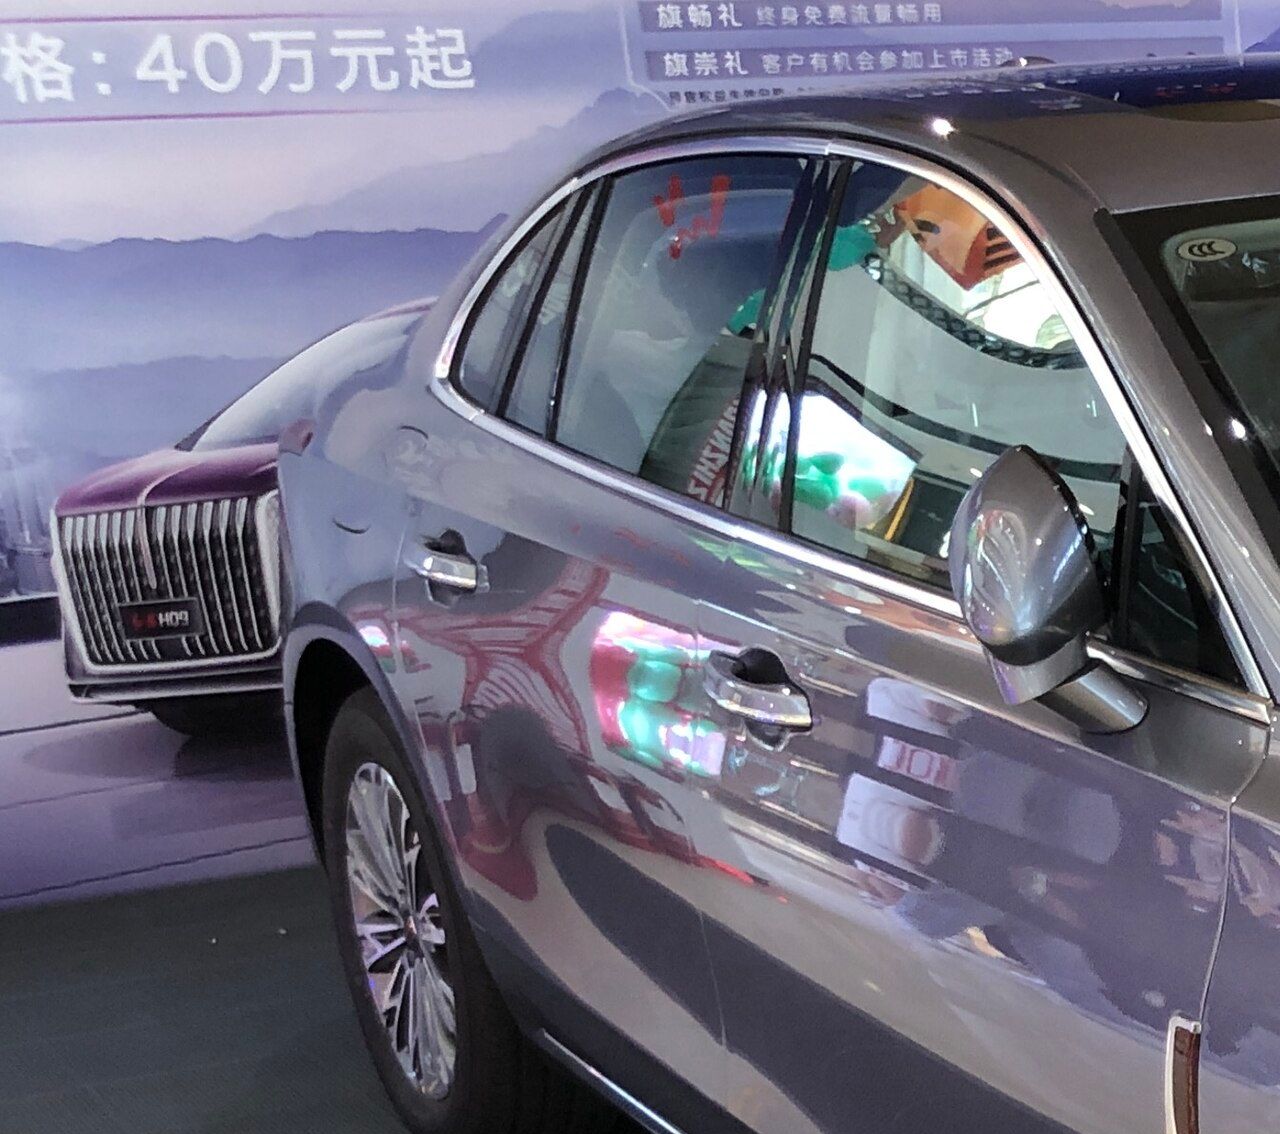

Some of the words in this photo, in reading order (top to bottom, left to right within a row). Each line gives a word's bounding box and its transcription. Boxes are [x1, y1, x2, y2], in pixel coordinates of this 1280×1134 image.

[656, 3, 743, 29] 旗畅礼
[756, 3, 942, 26] 终身免费流量畅用
[663, 51, 748, 77] 旗崇礼
